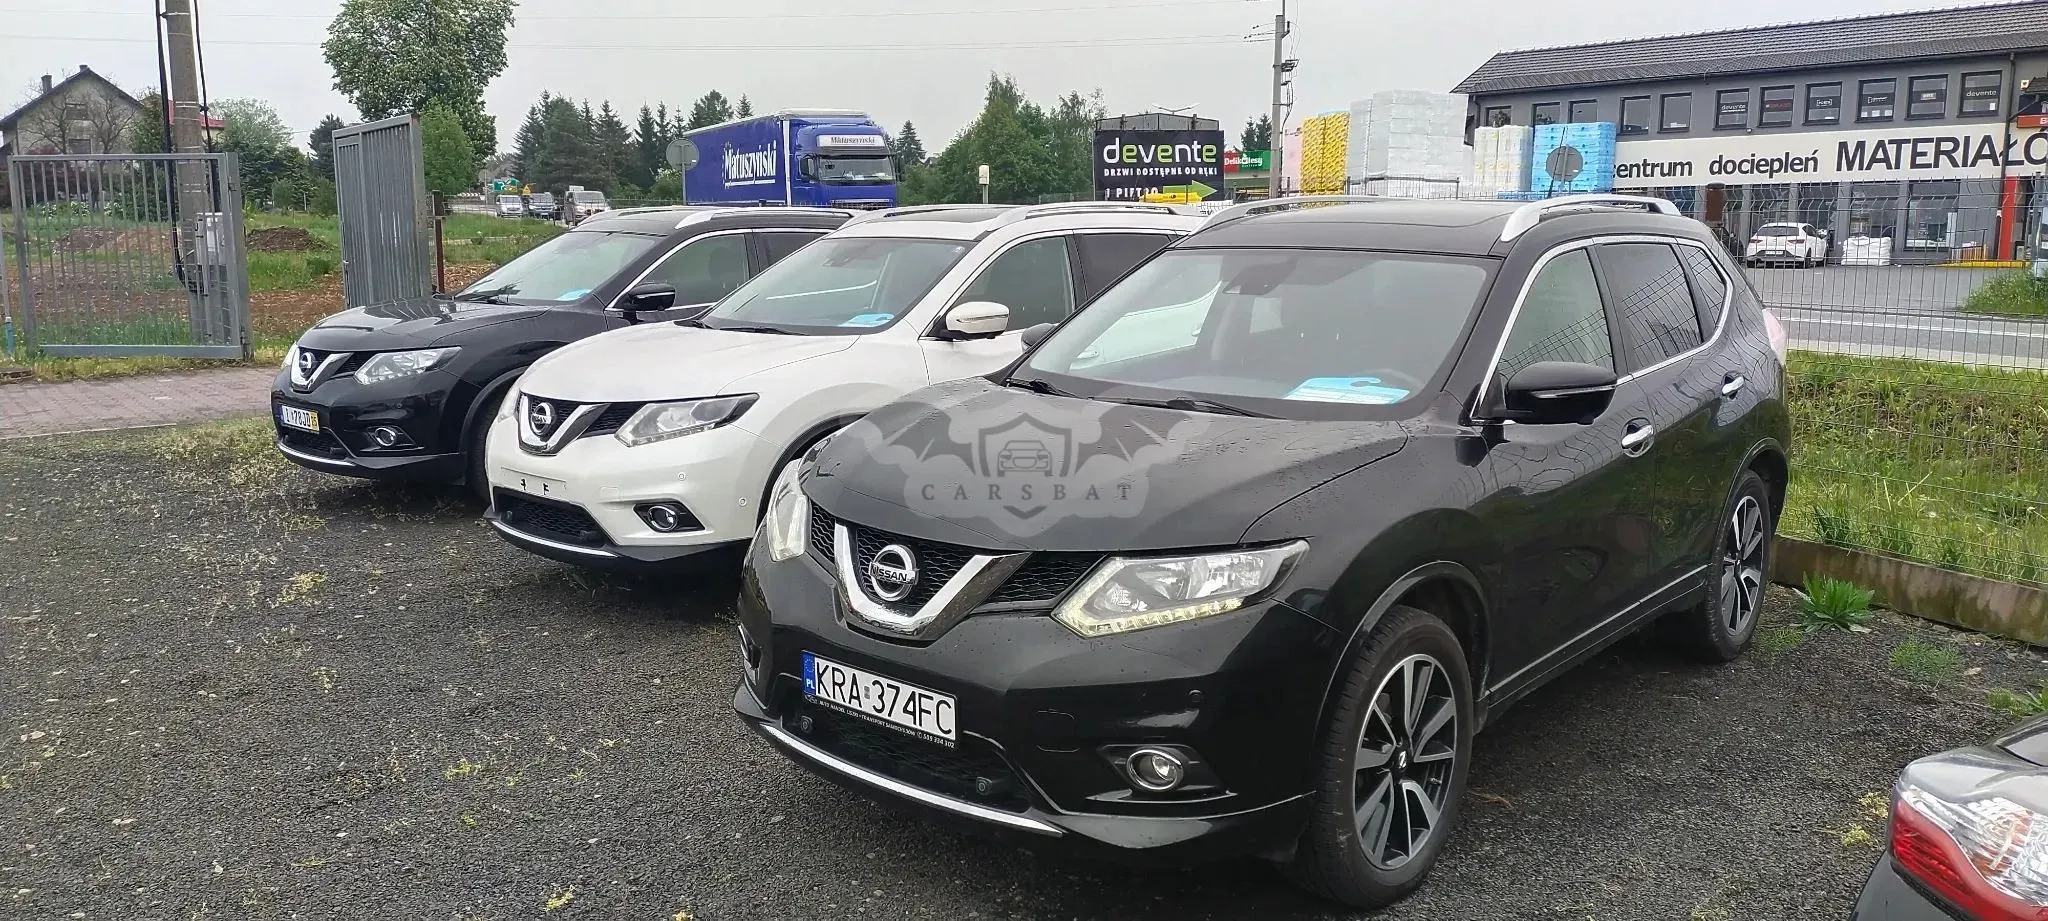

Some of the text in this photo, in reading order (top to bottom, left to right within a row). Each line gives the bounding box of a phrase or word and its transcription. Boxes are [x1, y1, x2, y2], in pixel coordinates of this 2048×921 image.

[1103, 138, 1217, 164] devente
[1104, 168, 1134, 176] DRZWI
[1185, 167, 1197, 175] OD
[1611, 149, 1819, 179] entrum dociepleń
[871, 567, 907, 581] NISSAN
[806, 678, 815, 689] PL
[816, 662, 952, 735] KRA 374FC
